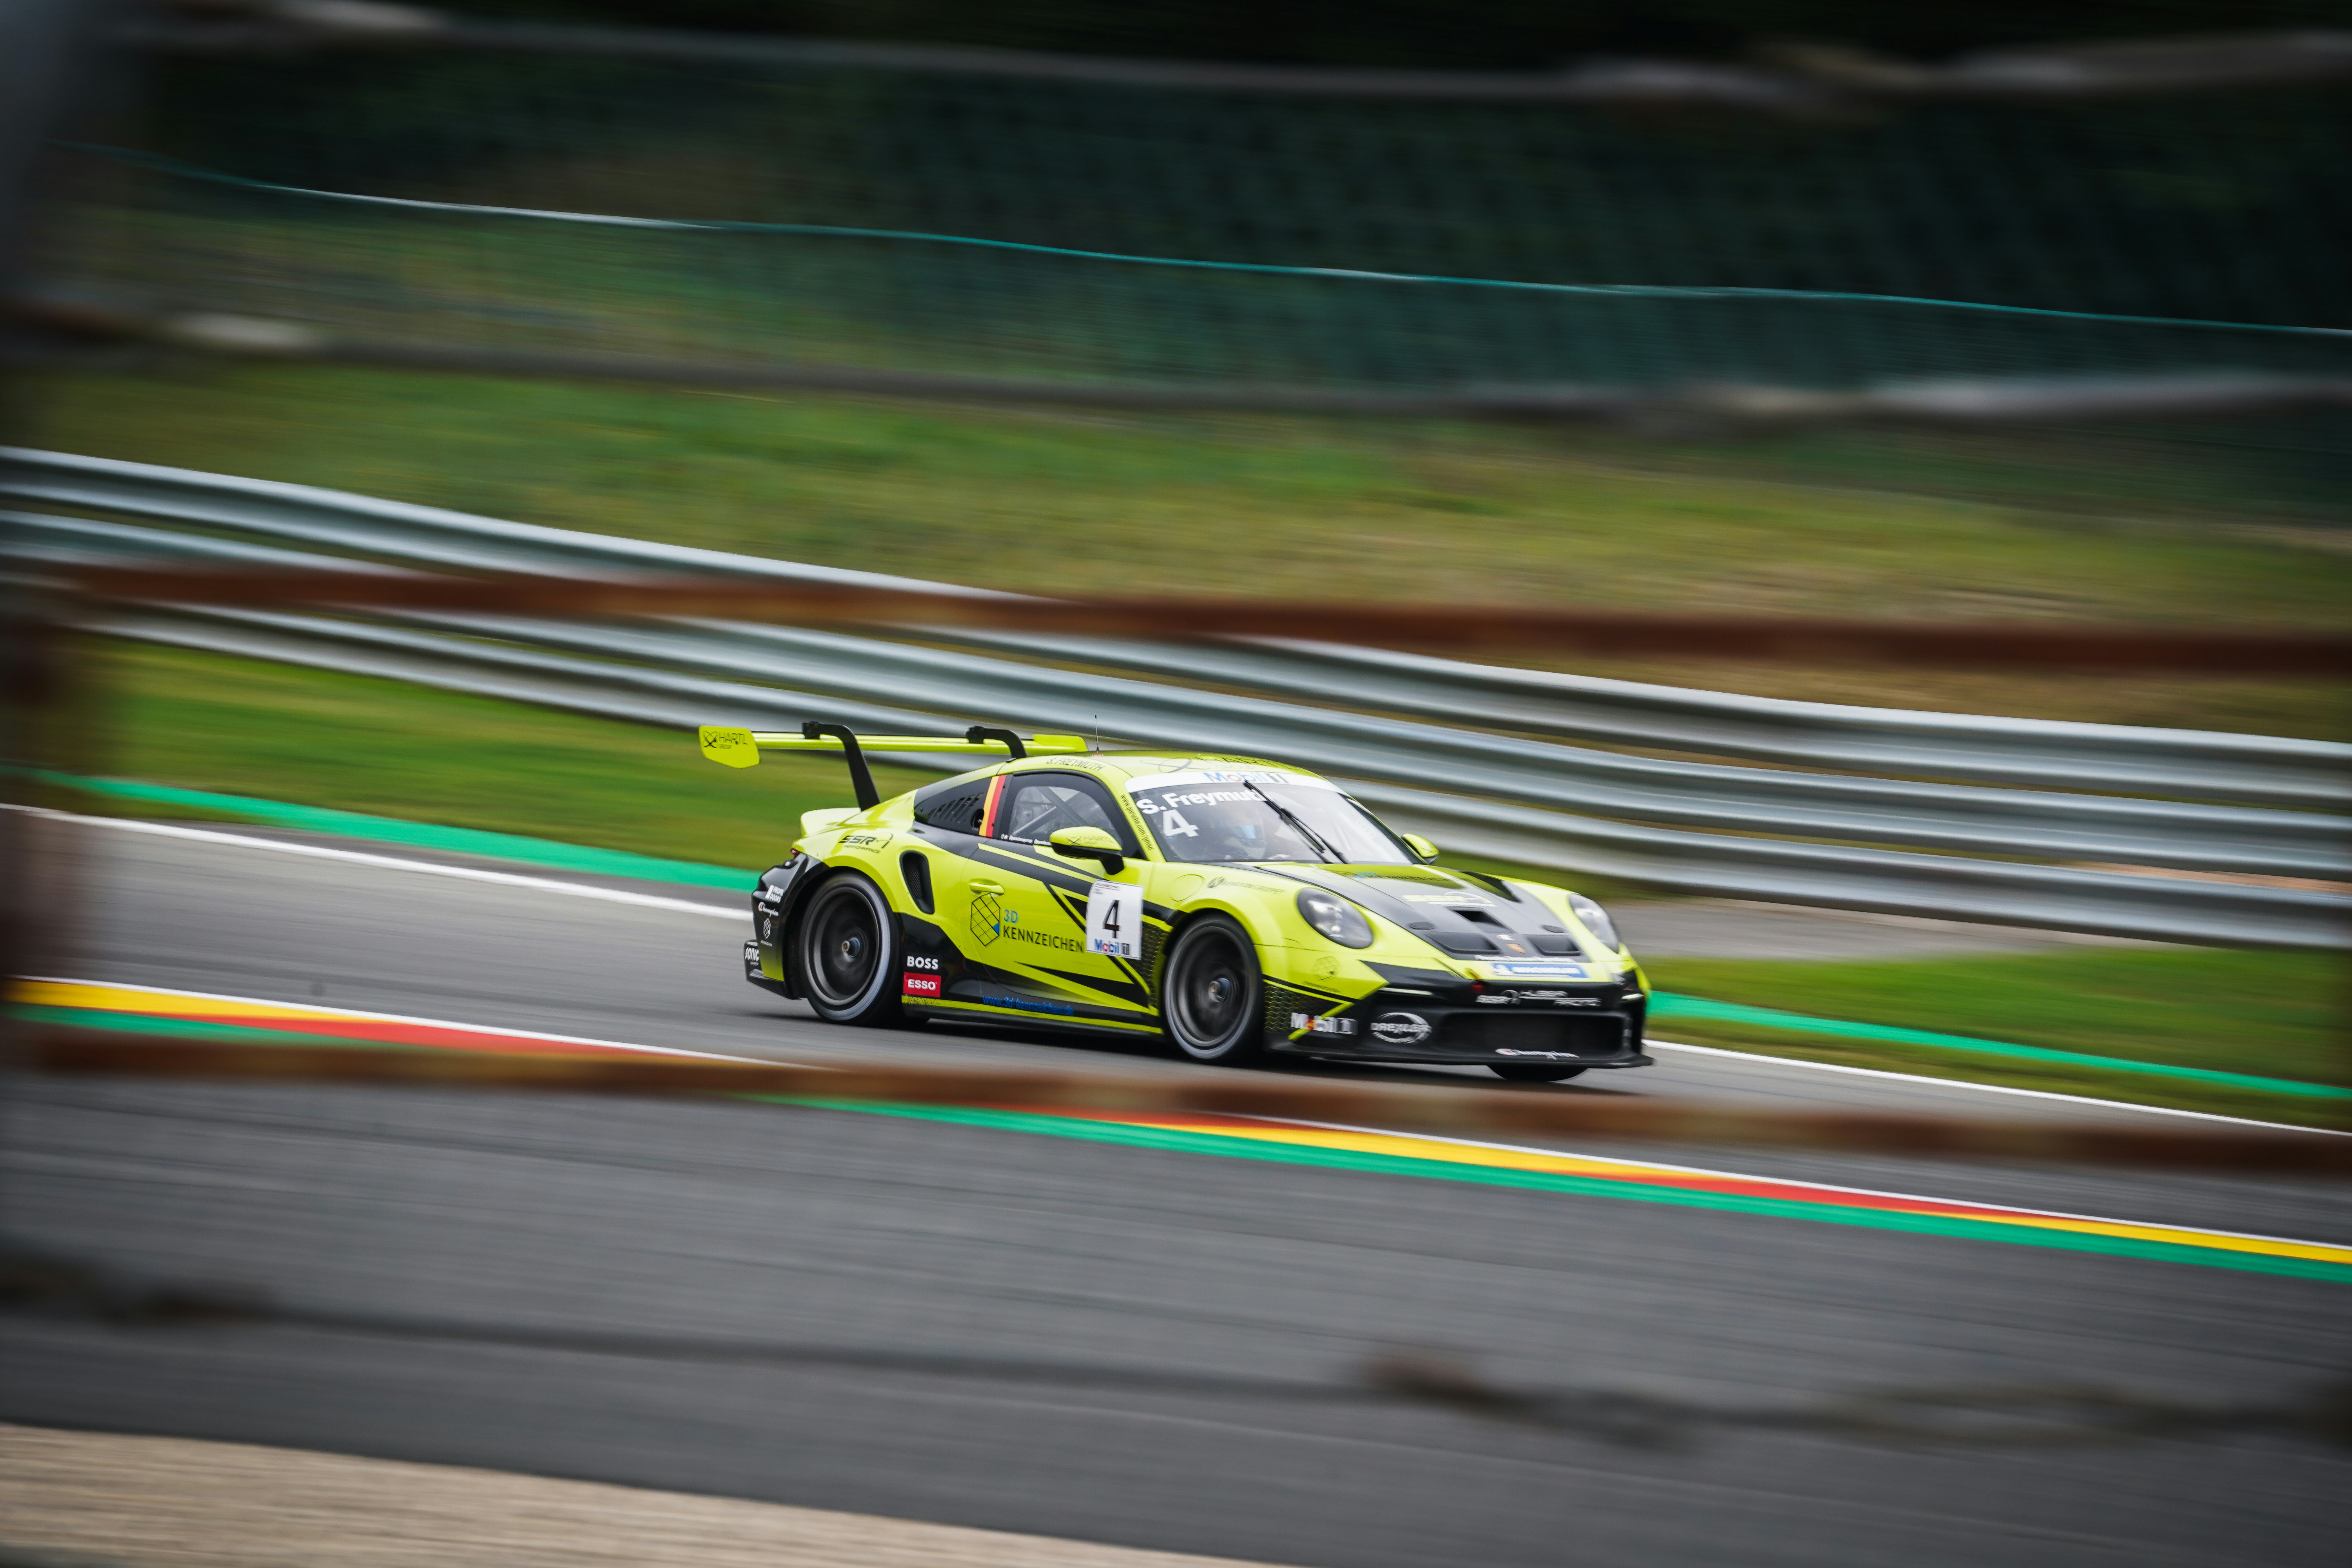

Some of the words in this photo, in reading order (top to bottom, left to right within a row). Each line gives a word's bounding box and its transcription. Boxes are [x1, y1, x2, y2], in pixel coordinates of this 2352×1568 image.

[719, 732, 748, 745] HARTL
[1054, 757, 1106, 771] FREYMUTH
[1203, 772, 1267, 782] Mobil
[1136, 799, 1167, 814] S.
[1163, 809, 1200, 837] 4
[838, 835, 877, 845] SSR
[758, 901, 779, 917] Champion
[1004, 909, 1018, 923] 3D
[1102, 899, 1120, 938] 4
[1003, 925, 1084, 953] KENNZEICHEN
[1094, 939, 1120, 954] Mobil
[907, 956, 939, 971] BOSS
[908, 979, 936, 991] ESSO
[1291, 1012, 1338, 1032] Mobil
